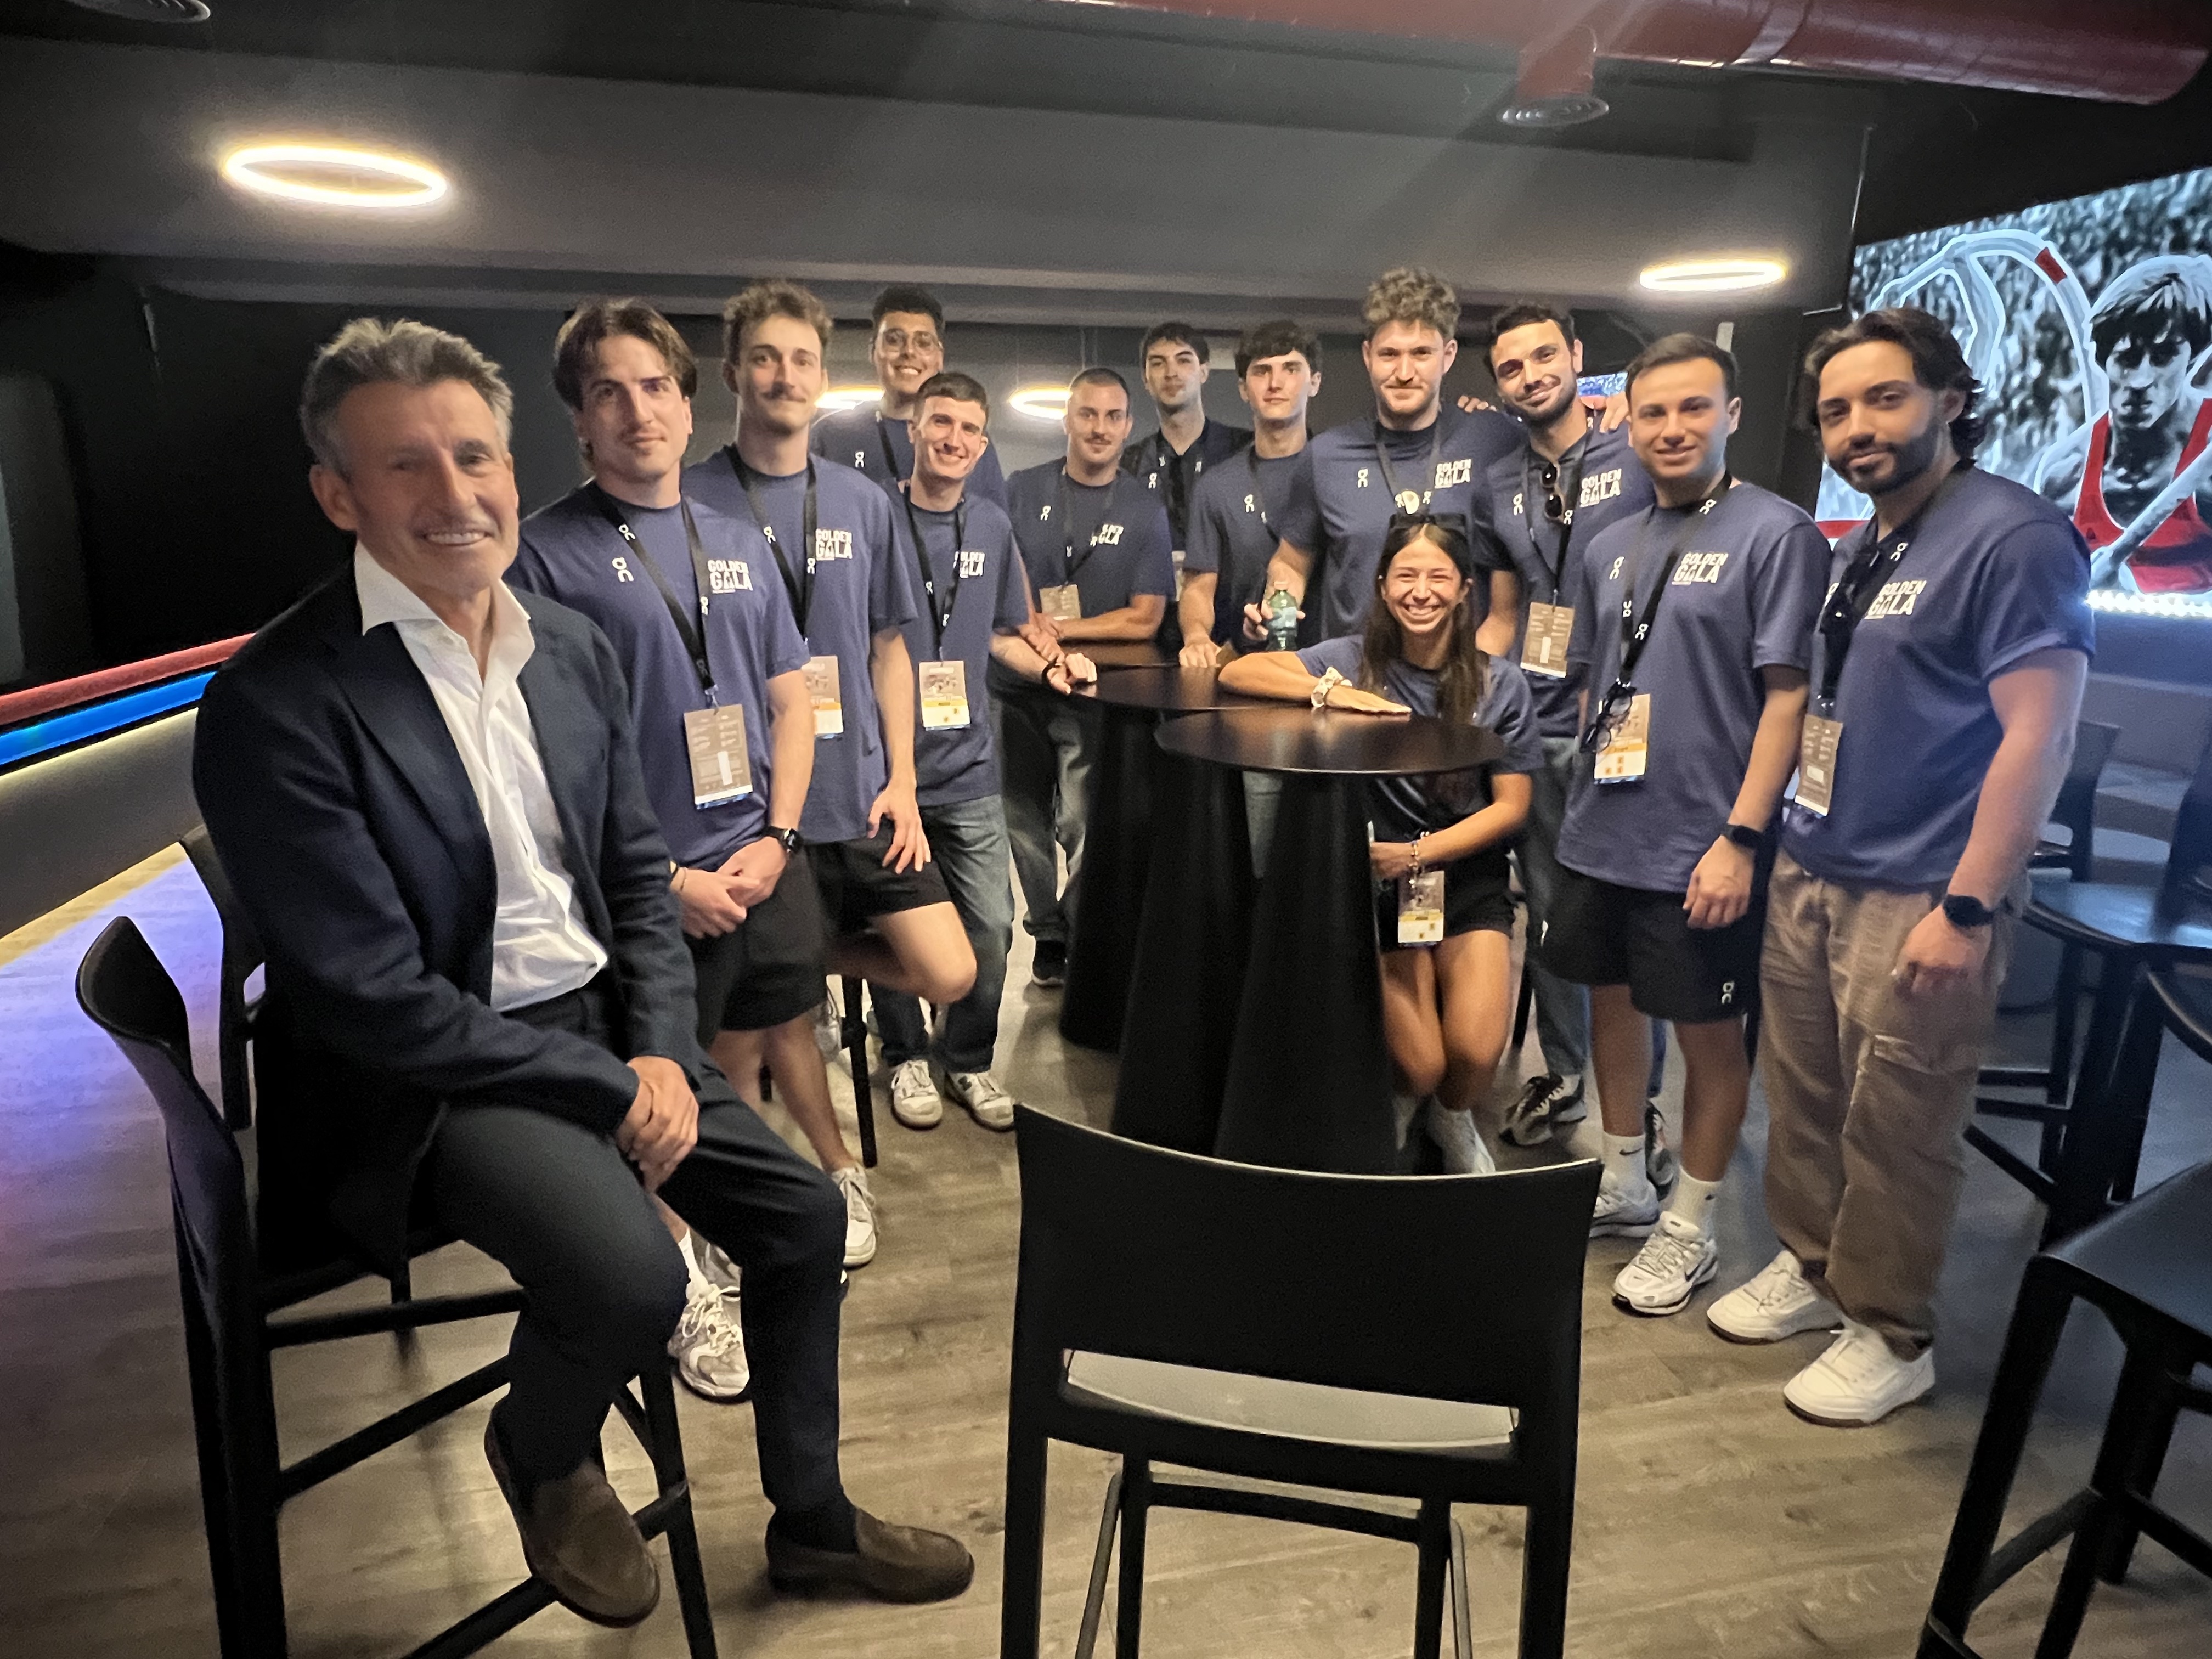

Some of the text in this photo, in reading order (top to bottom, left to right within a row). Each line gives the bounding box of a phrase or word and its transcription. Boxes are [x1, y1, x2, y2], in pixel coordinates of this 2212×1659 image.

[1581, 468, 1622, 490] GOLDEN
[1580, 480, 1621, 504] GALA
[815, 540, 853, 558] GALA
[708, 560, 749, 574] GOLDEN
[1681, 552, 1729, 566] GOLDEN
[710, 571, 753, 591] GALA
[1673, 564, 1720, 583] GALA
[1867, 594, 1917, 615] GALA
